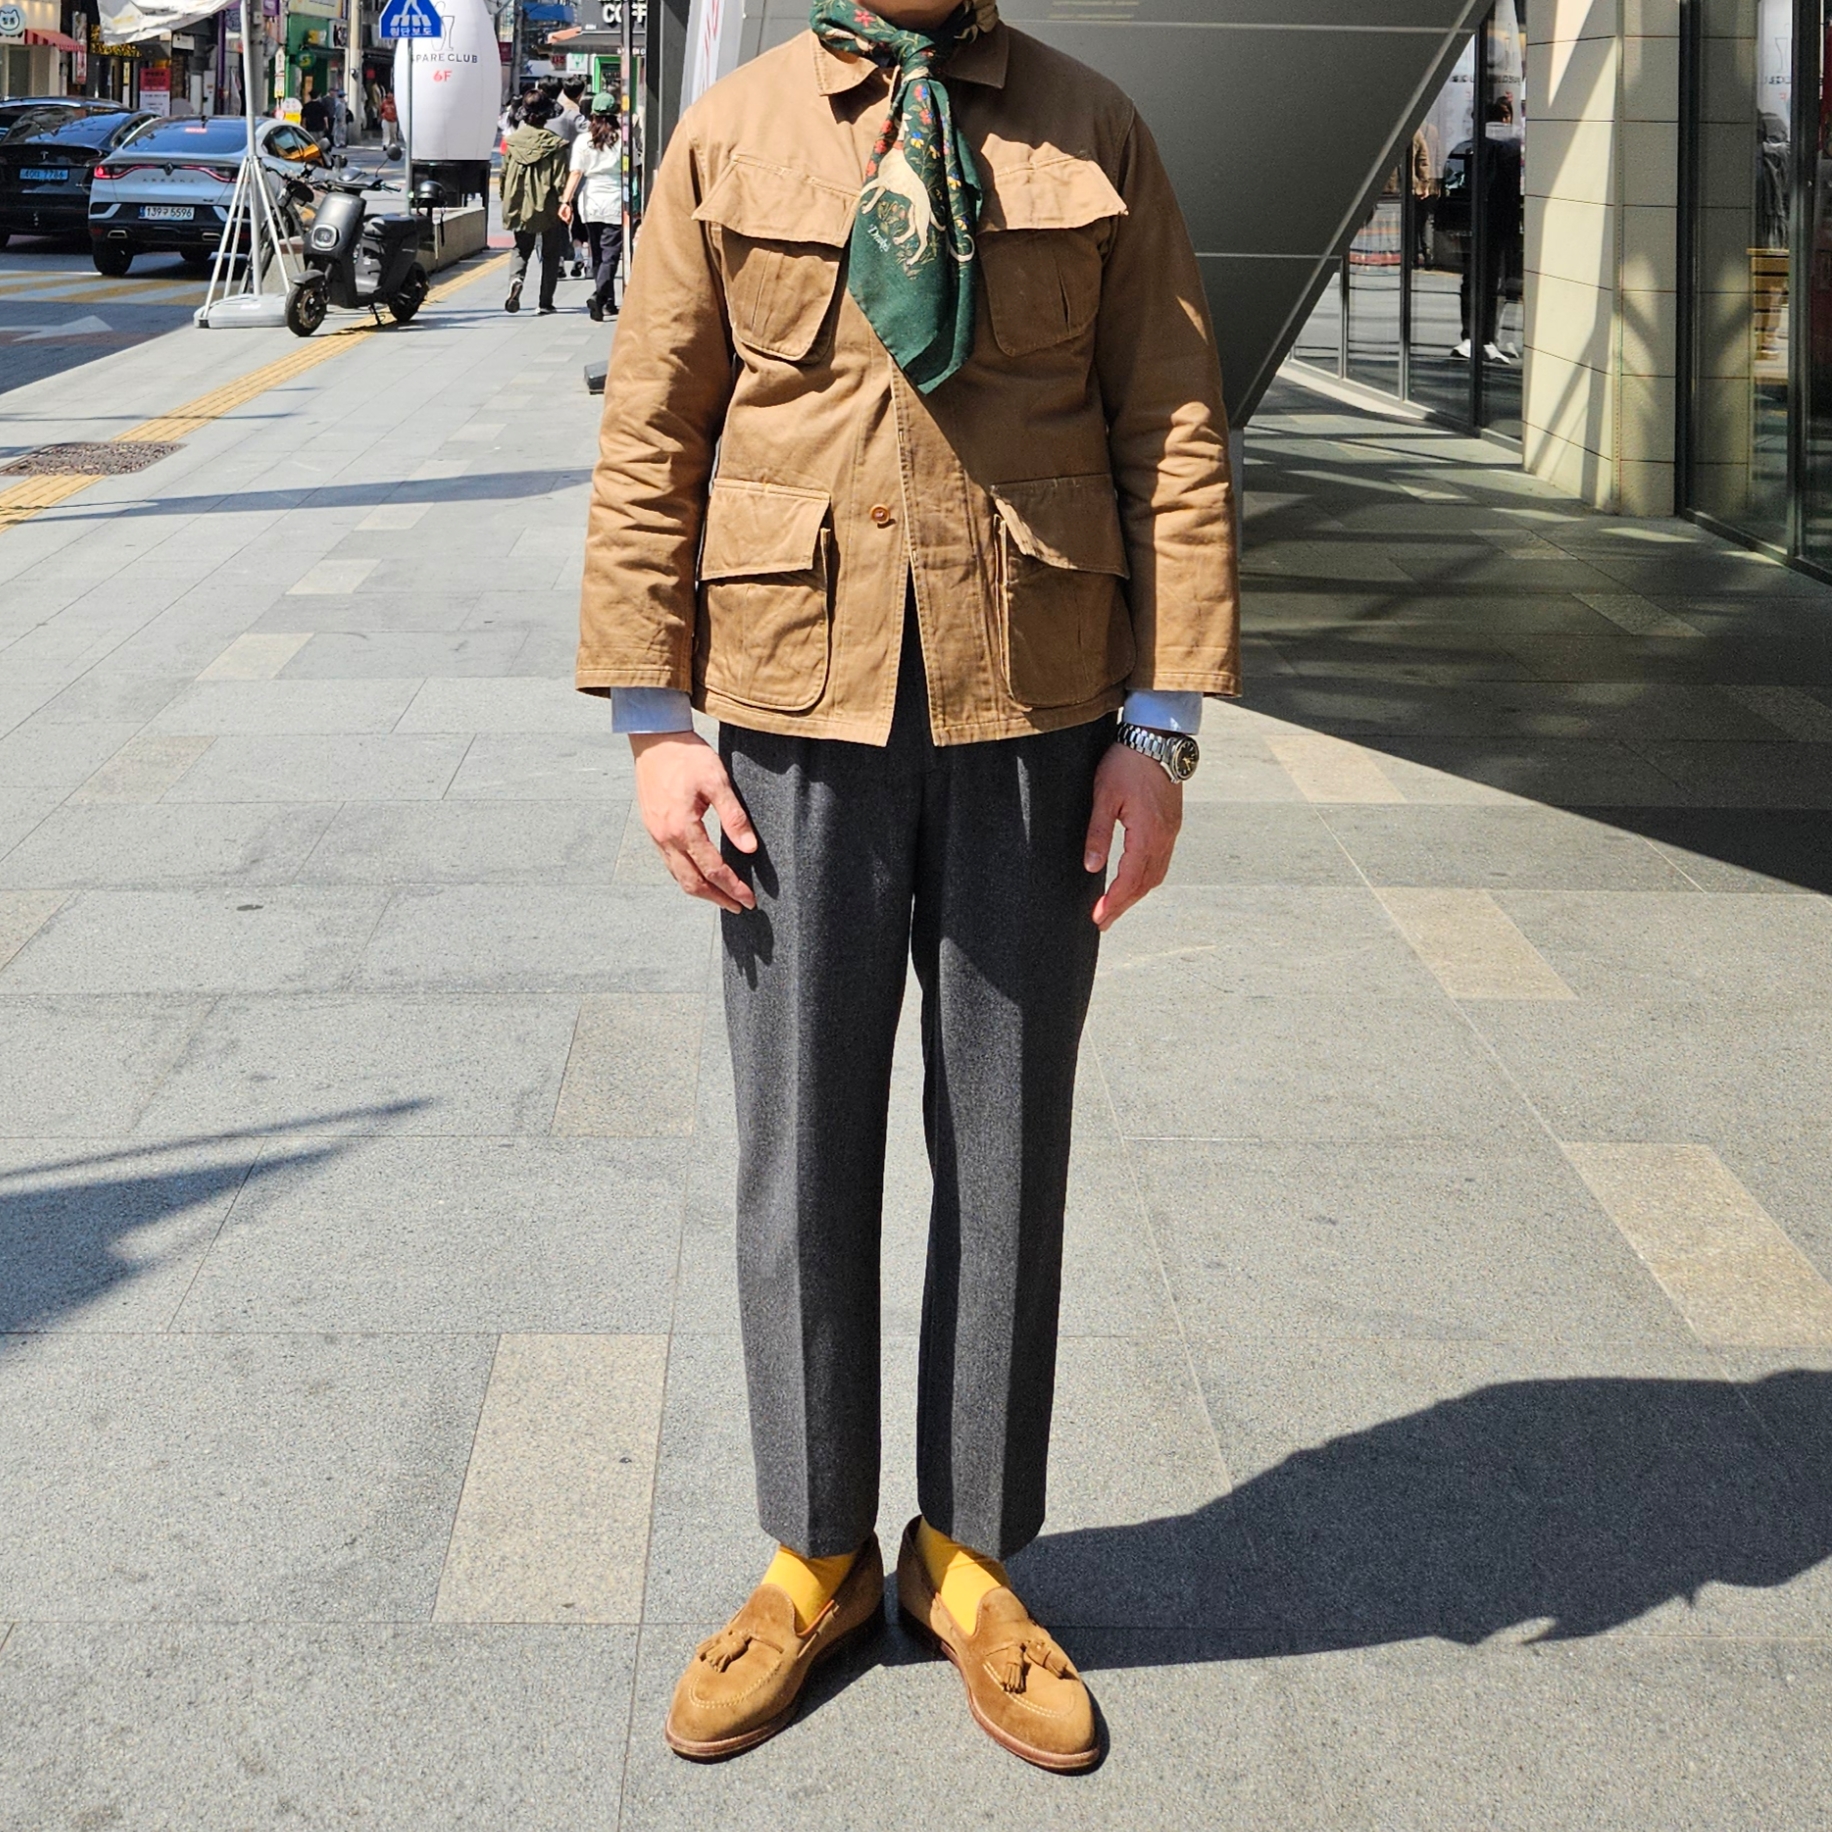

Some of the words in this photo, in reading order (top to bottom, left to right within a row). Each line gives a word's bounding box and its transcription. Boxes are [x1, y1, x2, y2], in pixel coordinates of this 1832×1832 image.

[390, 27, 433, 37] 횡단보도
[447, 53, 479, 64] CLUB
[433, 69, 453, 83] 6F
[170, 207, 193, 219] 5596
